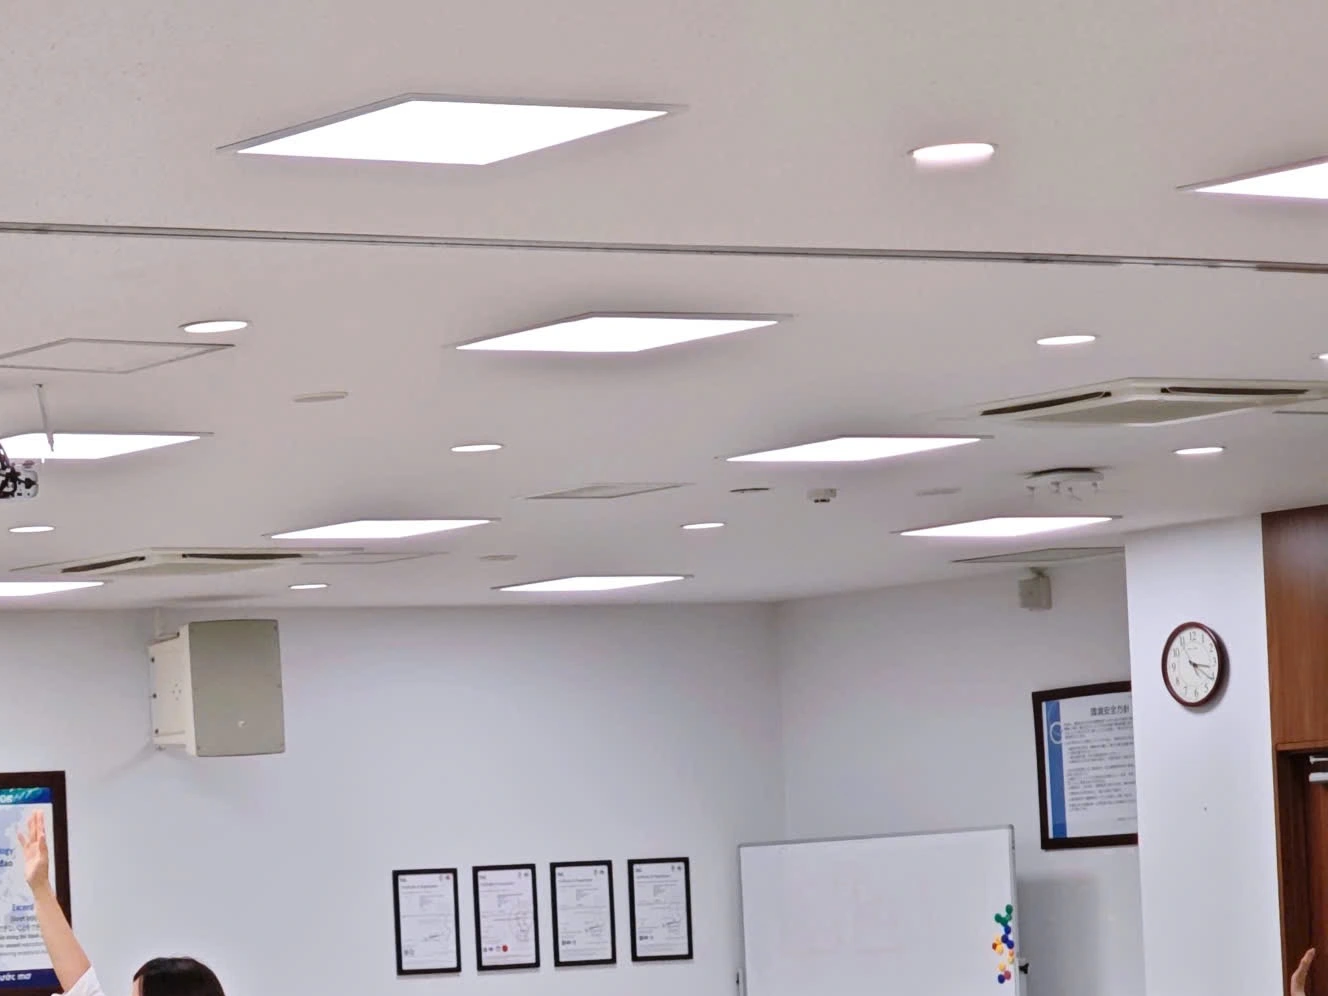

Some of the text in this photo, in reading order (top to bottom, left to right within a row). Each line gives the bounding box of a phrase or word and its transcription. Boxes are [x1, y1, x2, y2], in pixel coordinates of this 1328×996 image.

[1189, 631, 1197, 641] 12
[1173, 648, 1180, 657] 10
[1171, 663, 1176, 672] 9
[1194, 687, 1199, 697] 6
